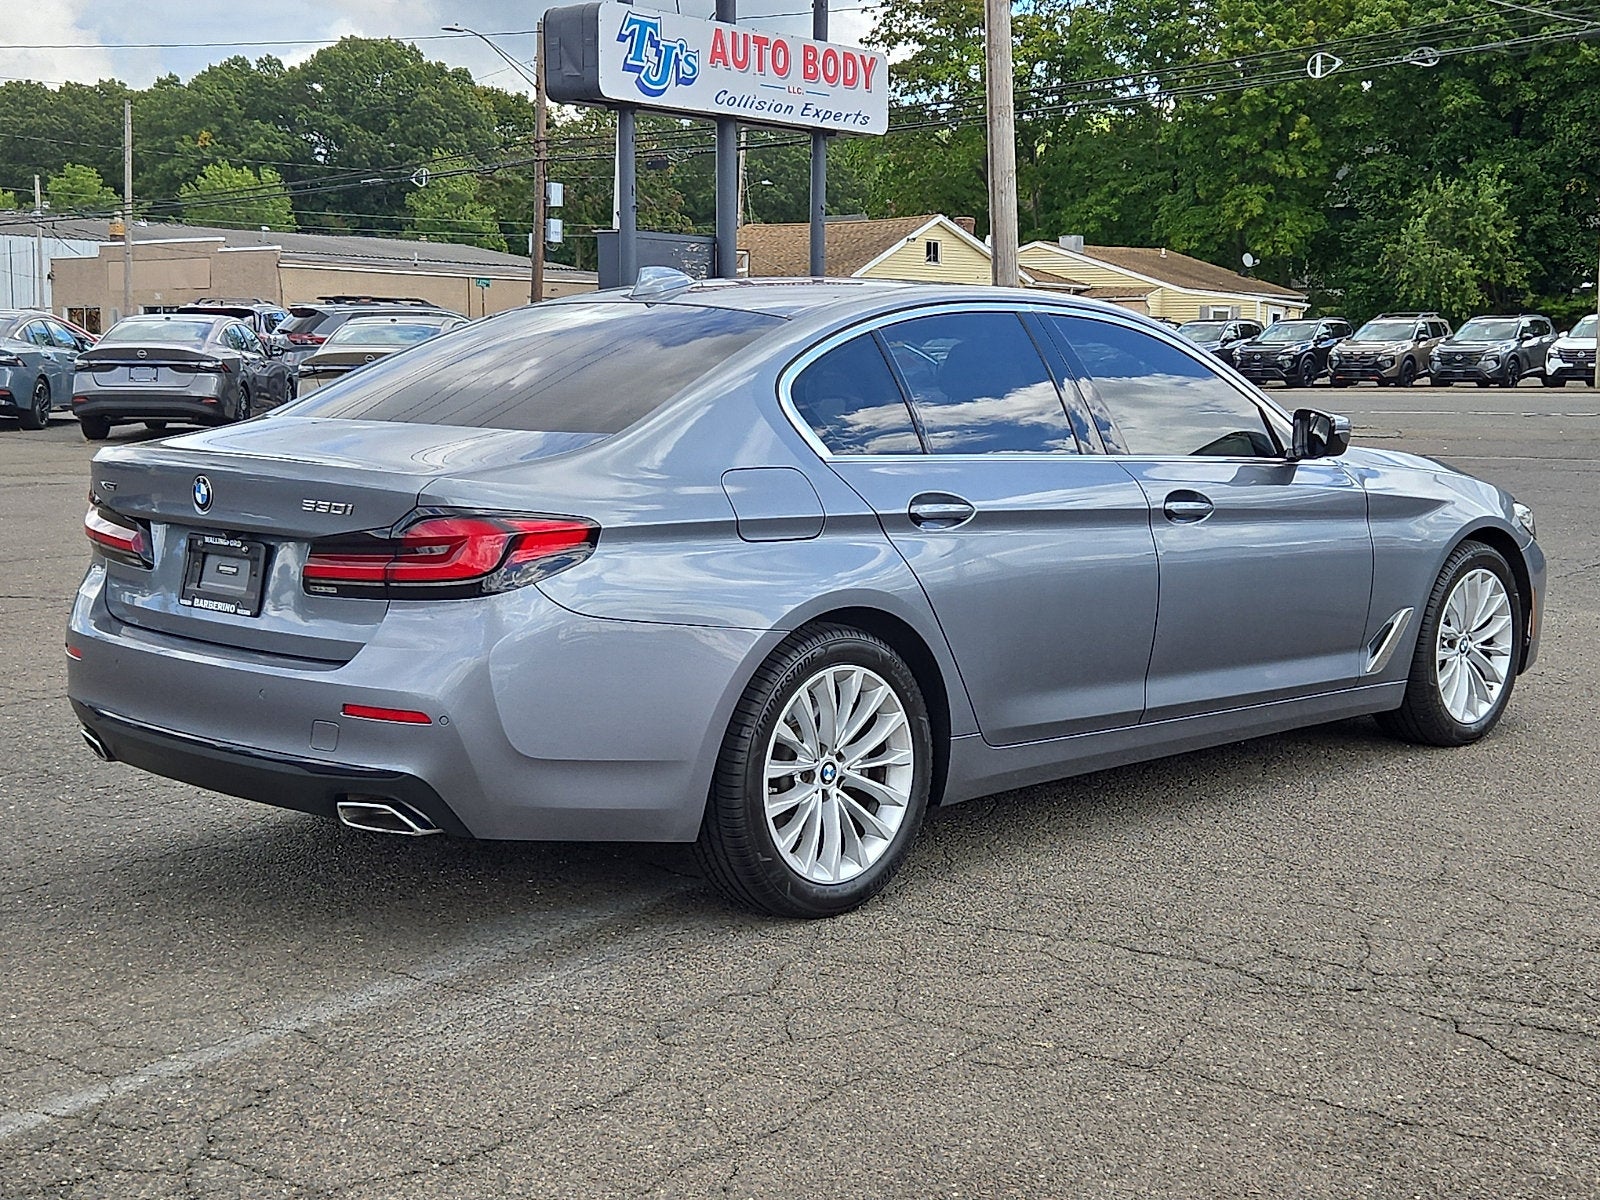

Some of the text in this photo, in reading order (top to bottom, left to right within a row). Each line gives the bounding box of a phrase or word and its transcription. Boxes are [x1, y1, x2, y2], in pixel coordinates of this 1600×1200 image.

[616, 10, 877, 97] TJ's AUTO BODY
[787, 85, 805, 96] LLC.
[714, 89, 871, 127] Collision Experts
[301, 499, 354, 516] 530i
[193, 598, 236, 613] BARBERINO
